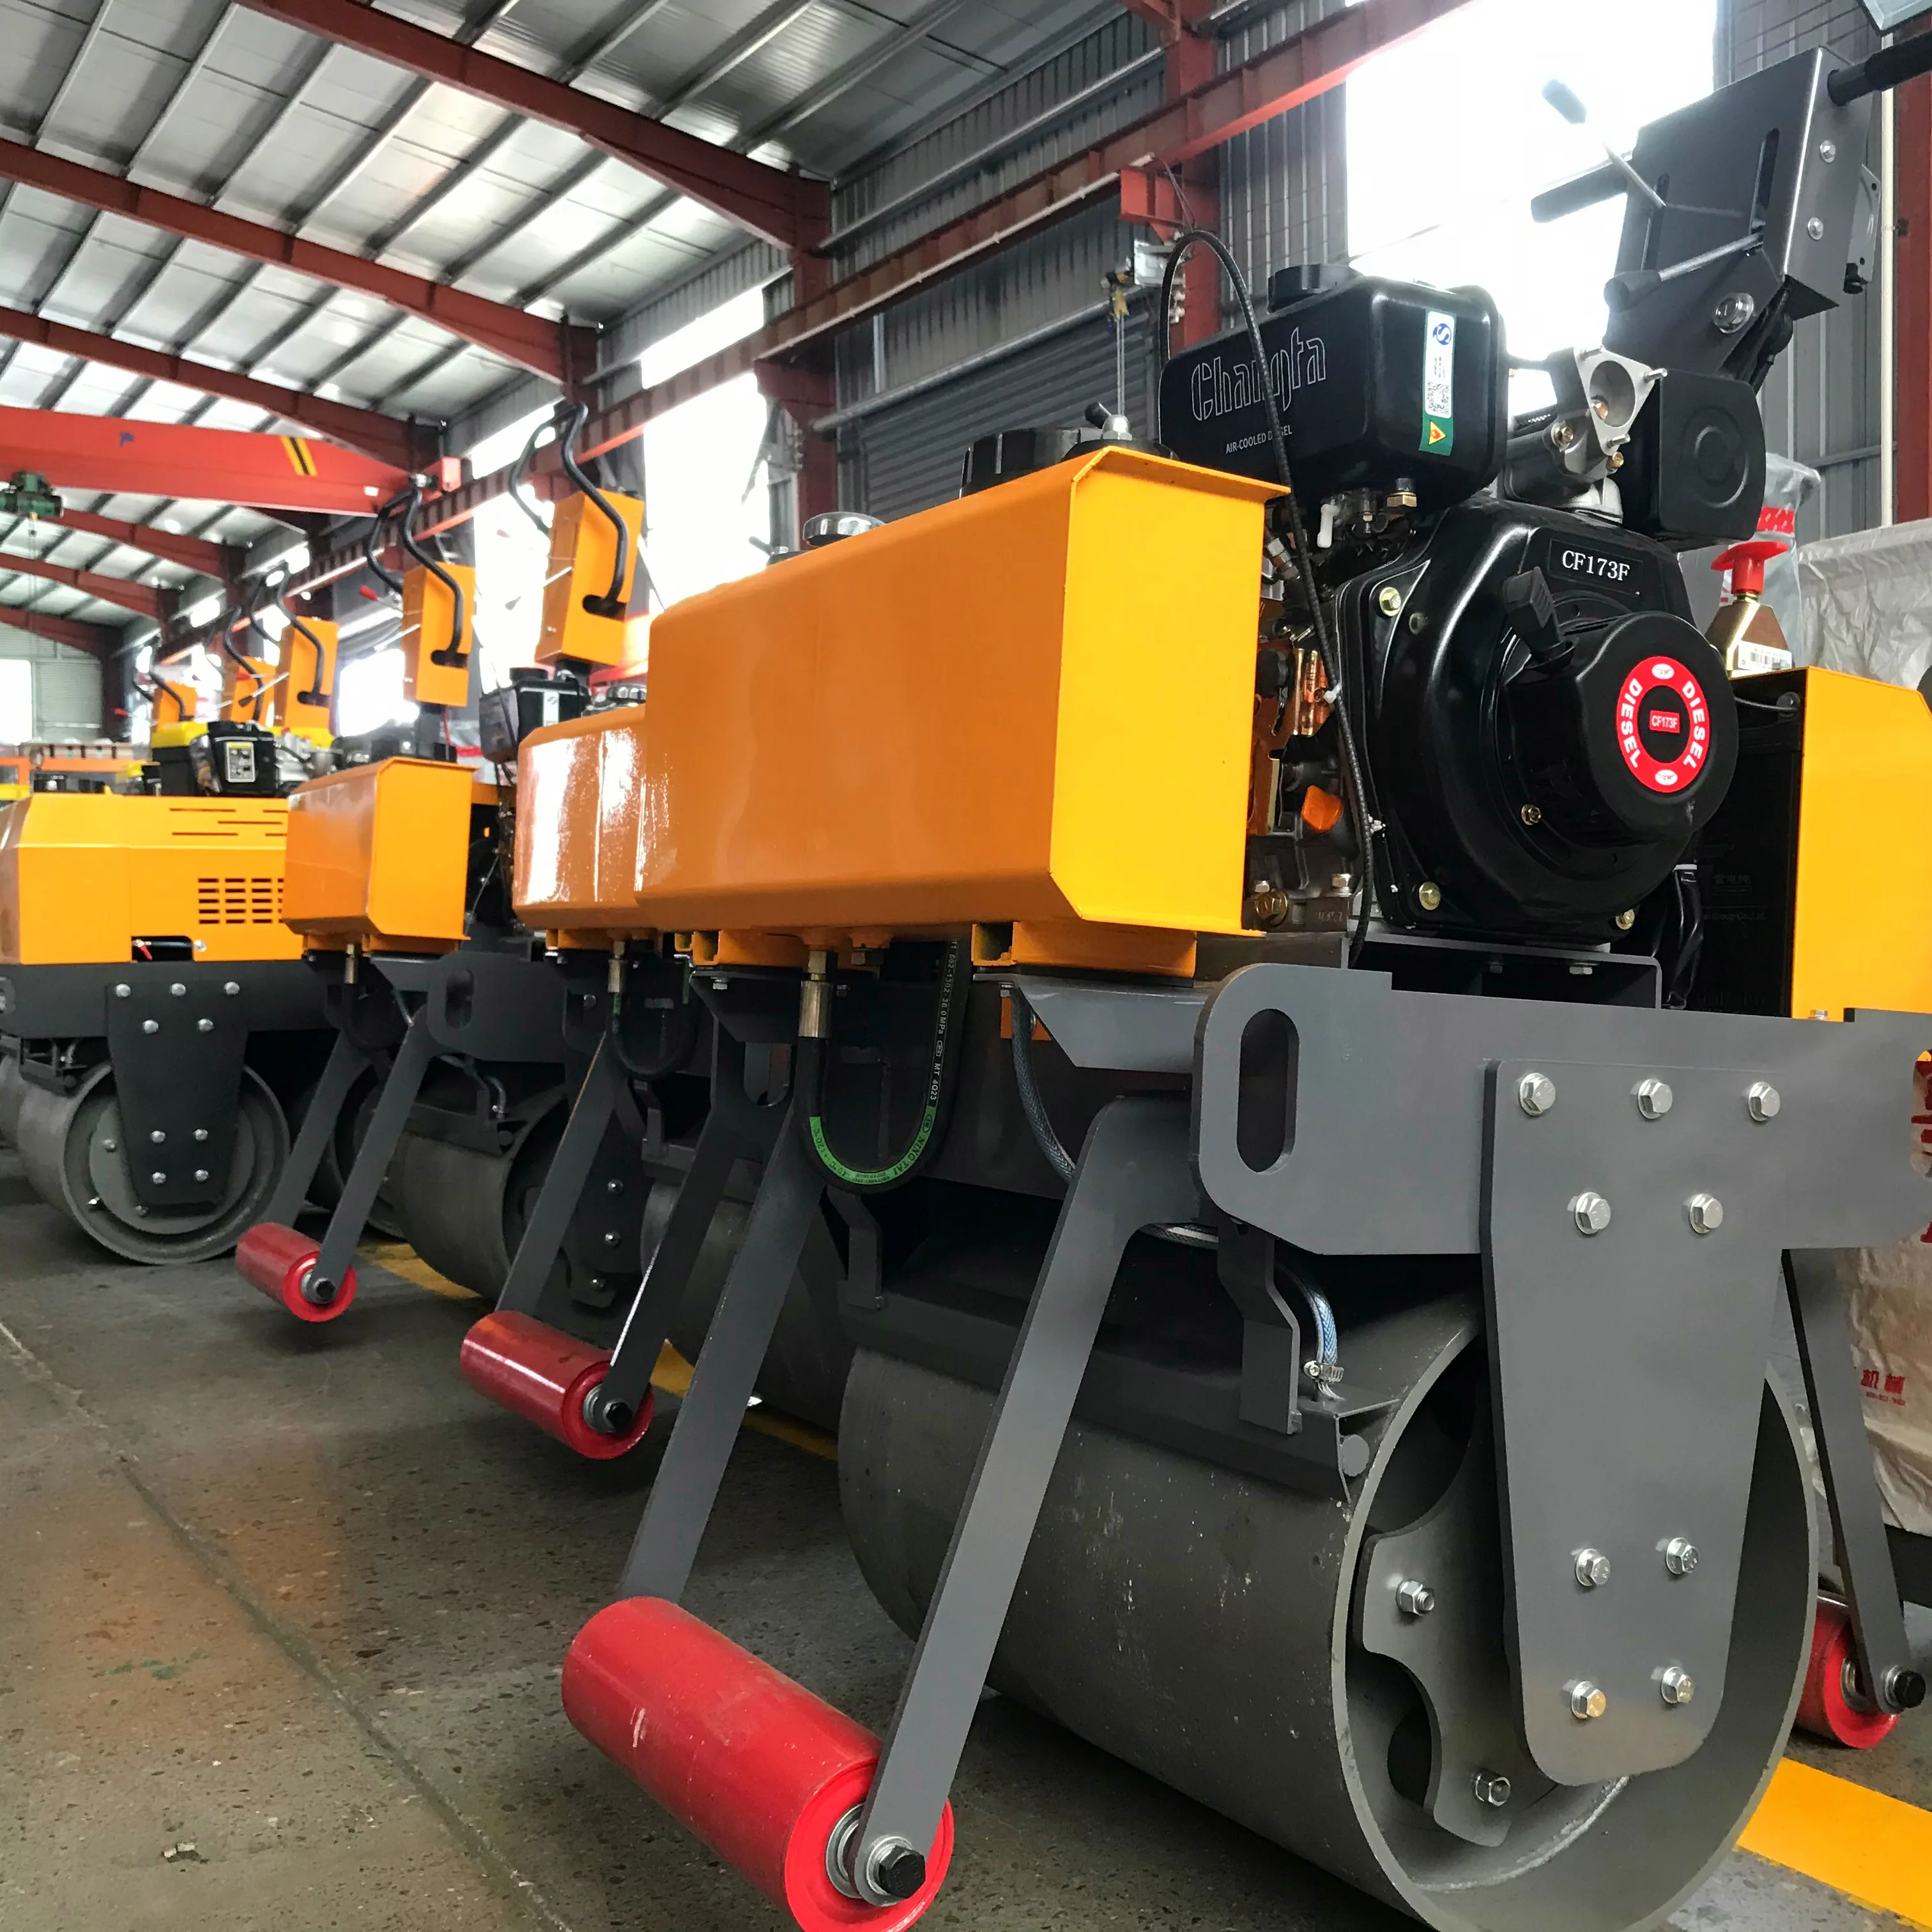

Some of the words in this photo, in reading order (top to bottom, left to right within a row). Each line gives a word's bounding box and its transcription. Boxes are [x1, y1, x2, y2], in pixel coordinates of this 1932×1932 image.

[1226, 433, 1266, 454] AIR-COOLED
[1562, 549, 1630, 581] CF173F
[1621, 678, 1643, 769] DIESEL
[1652, 715, 1678, 729] CF173F
[1682, 680, 1706, 769] DIESEL
[933, 1063, 941, 1076] MT
